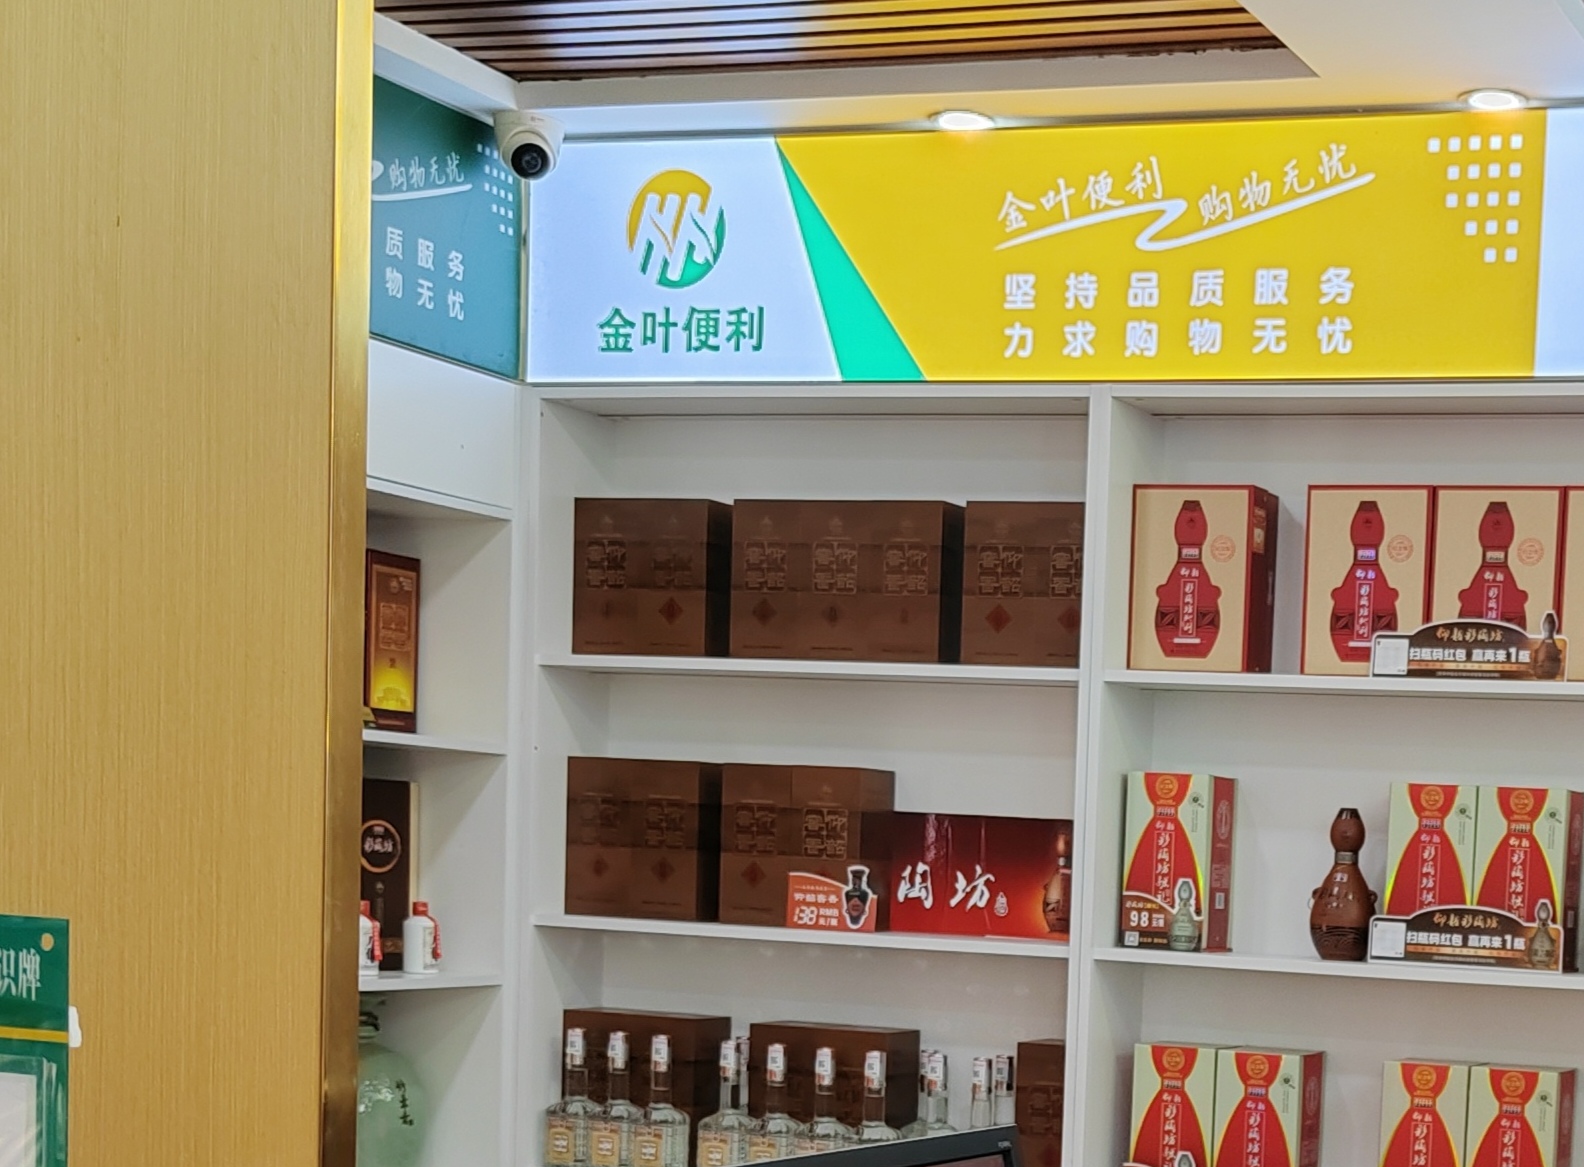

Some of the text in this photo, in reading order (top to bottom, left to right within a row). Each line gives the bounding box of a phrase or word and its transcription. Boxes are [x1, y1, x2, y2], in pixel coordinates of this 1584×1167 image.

[997, 143, 1358, 234] 金叶便利 购物无忧
[1003, 267, 1355, 310] 坚持品质服务
[597, 305, 765, 355] 金叶便利
[1003, 317, 1353, 359] 力求购物无忧
[1129, 911, 1149, 928] 98
